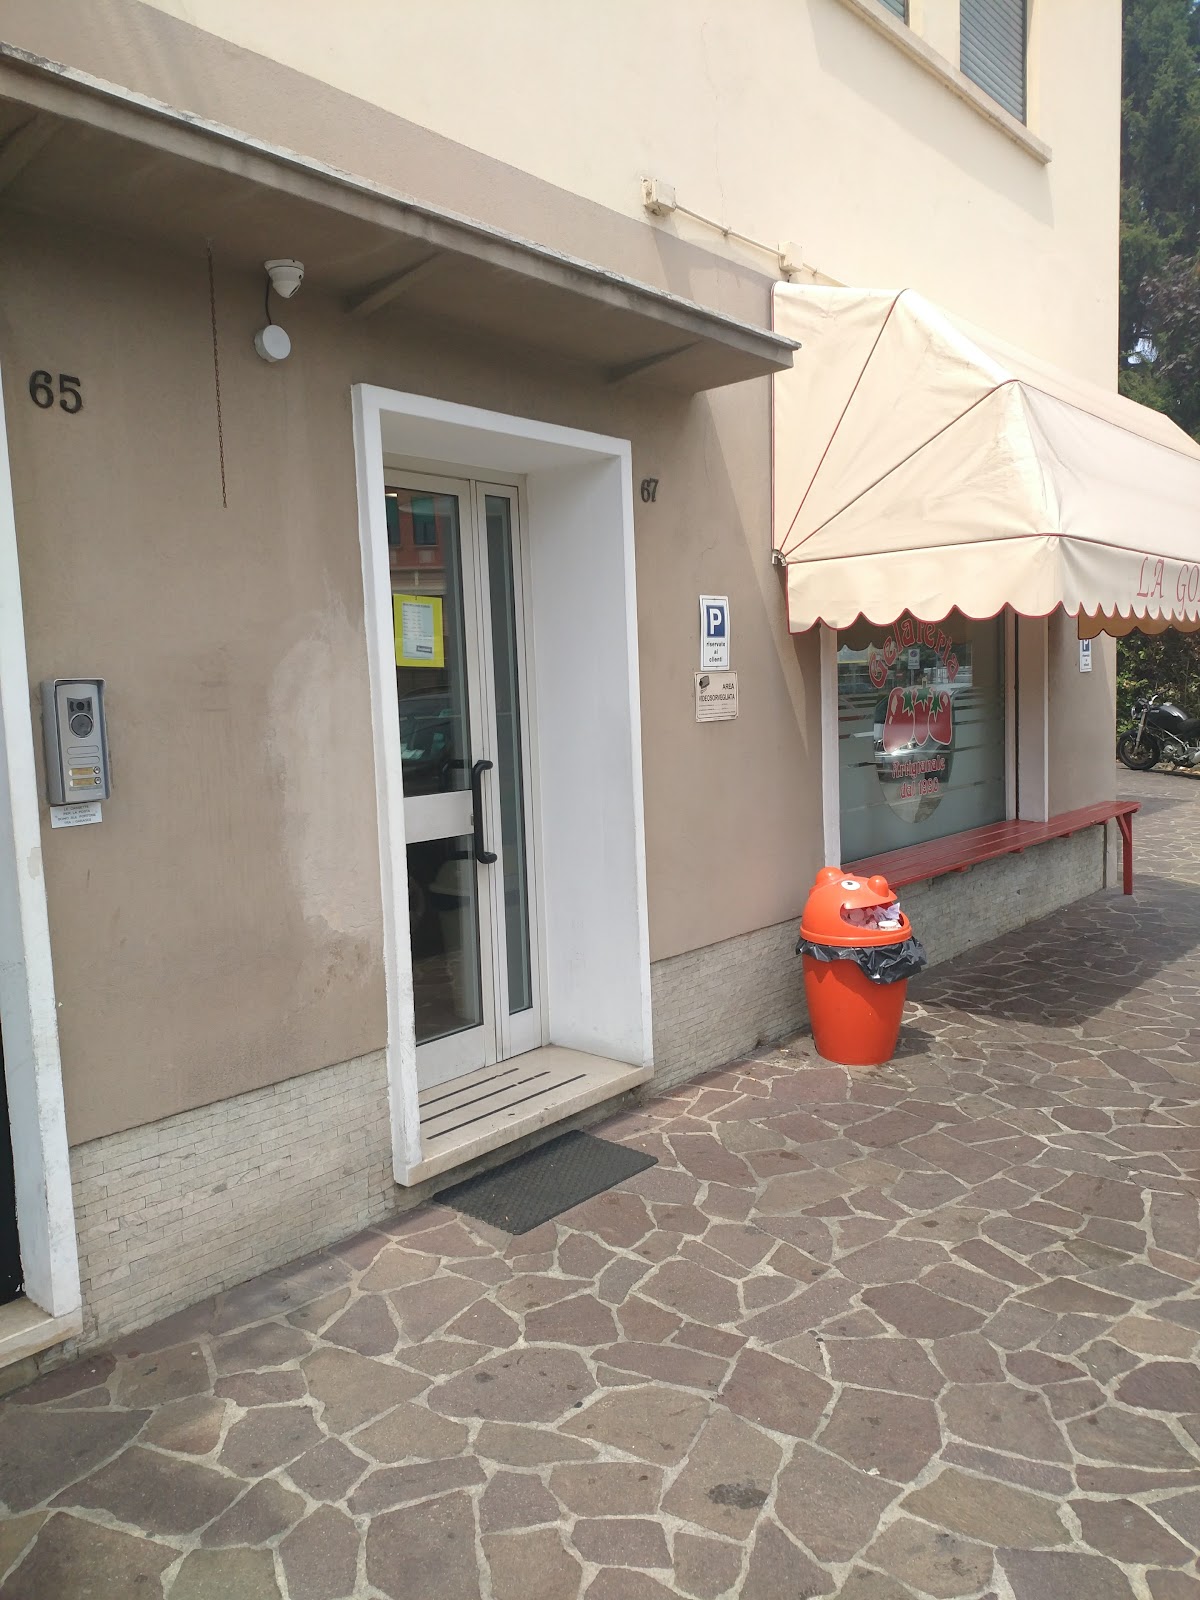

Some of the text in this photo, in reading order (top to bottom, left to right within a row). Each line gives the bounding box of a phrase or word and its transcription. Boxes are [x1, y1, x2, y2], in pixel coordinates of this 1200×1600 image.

[29, 370, 82, 414] 65
[640, 477, 659, 502] 67
[1137, 557, 1200, 616] LA GO
[709, 608, 722, 635] P
[892, 755, 945, 779] Artigianale
[900, 780, 916, 800] dal
